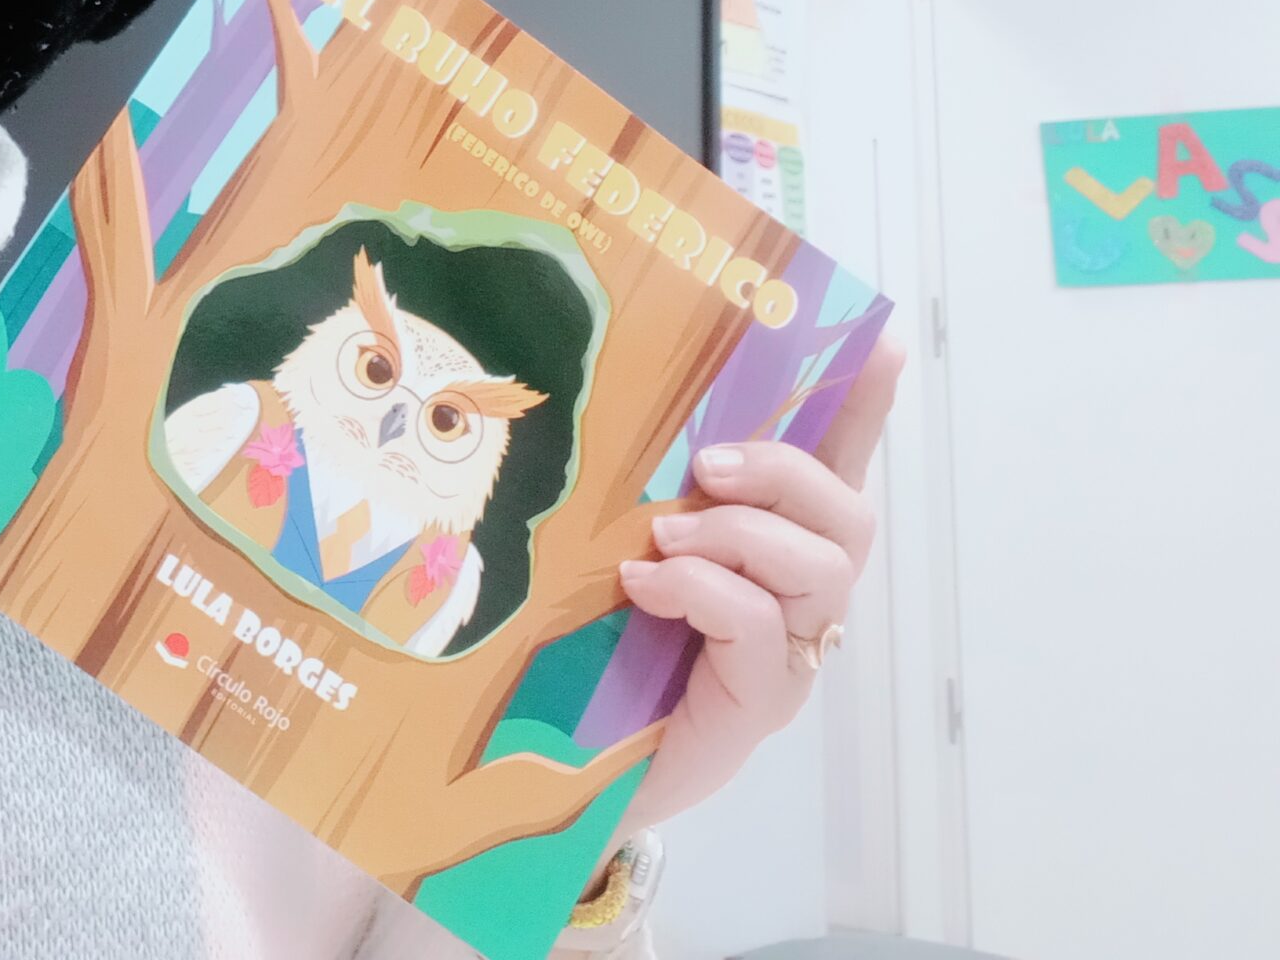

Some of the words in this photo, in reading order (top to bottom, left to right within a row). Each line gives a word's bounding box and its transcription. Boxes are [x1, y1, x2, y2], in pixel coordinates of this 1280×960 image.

[382, 5, 538, 138] BUHO
[537, 120, 798, 329] FEDERICO
[446, 122, 540, 198] (FEDERICO
[540, 191, 568, 219] DE
[567, 211, 613, 254] OWL)
[156, 553, 233, 626] LULA
[233, 608, 358, 711] BORGES
[196, 656, 252, 704] Círculo
[253, 696, 290, 731] Rojo
[211, 688, 257, 726] EDITORIAL
